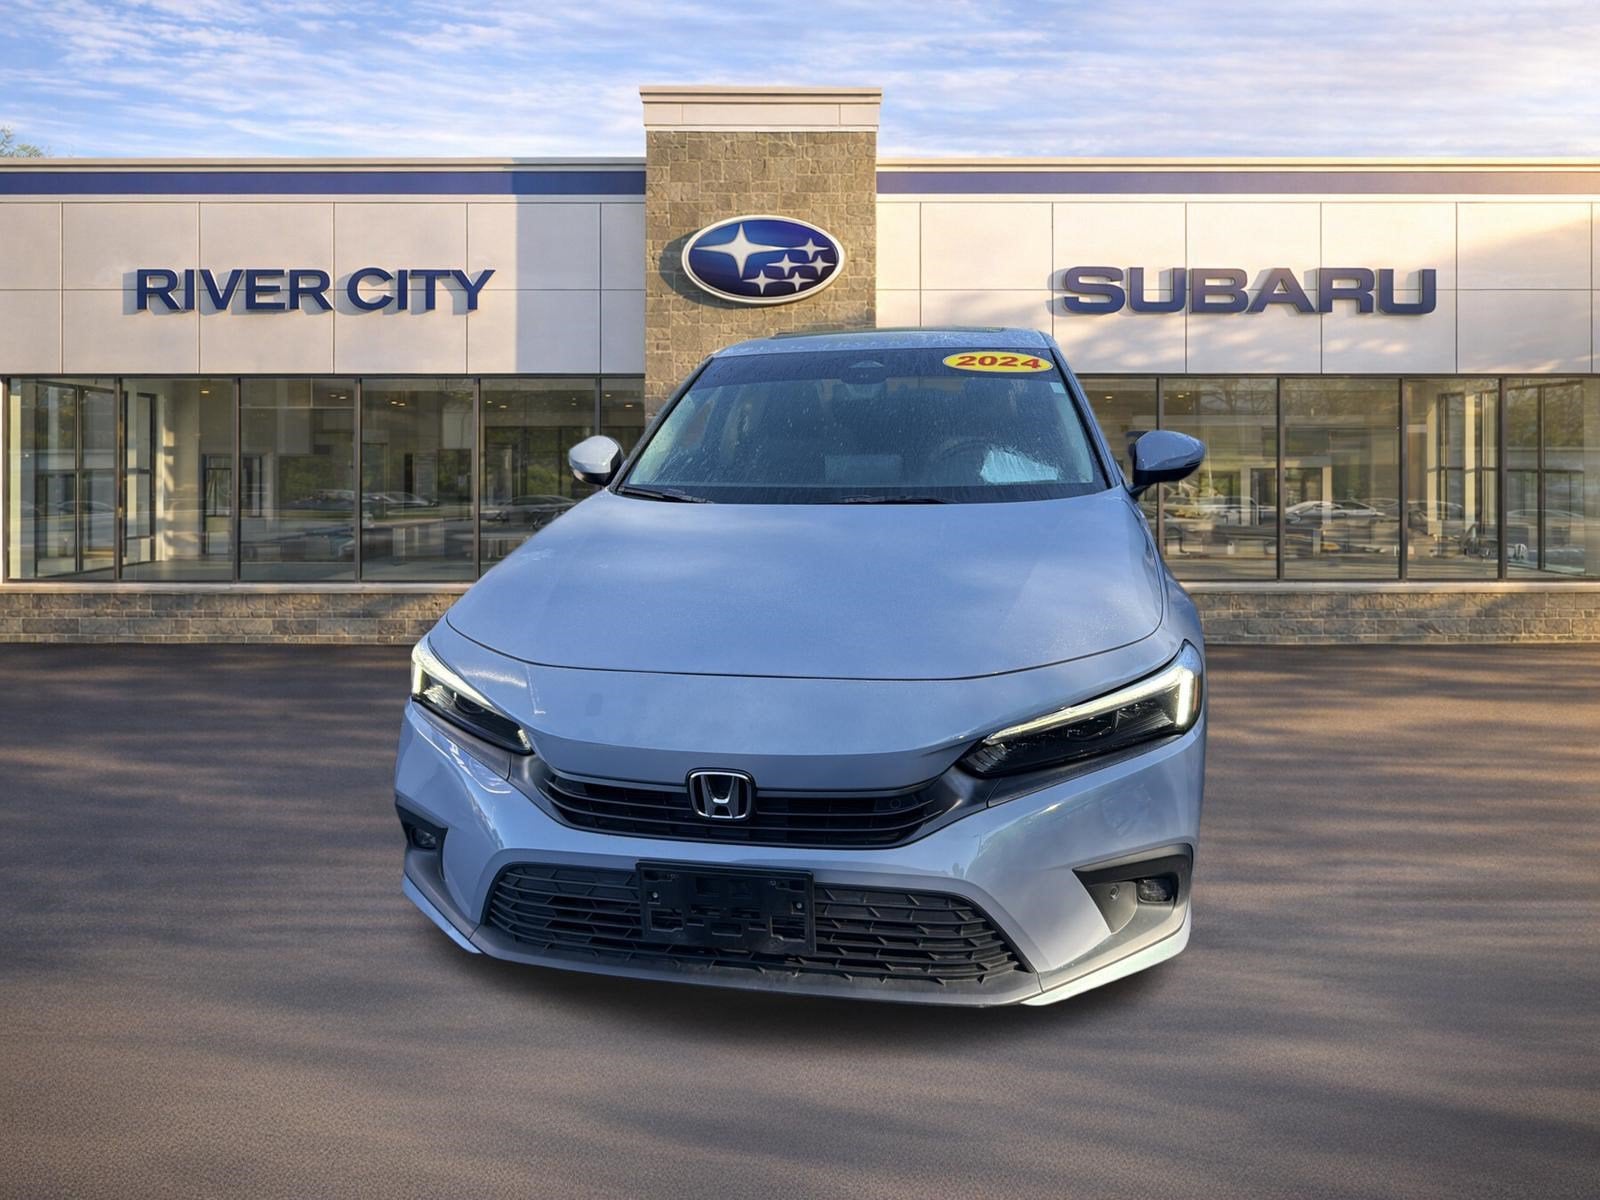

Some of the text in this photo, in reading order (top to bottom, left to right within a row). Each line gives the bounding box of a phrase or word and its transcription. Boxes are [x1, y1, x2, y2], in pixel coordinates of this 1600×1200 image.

[137, 267, 496, 310] RIVER CITY
[1064, 266, 1437, 314] SUBARU
[955, 355, 1042, 369] 2024
